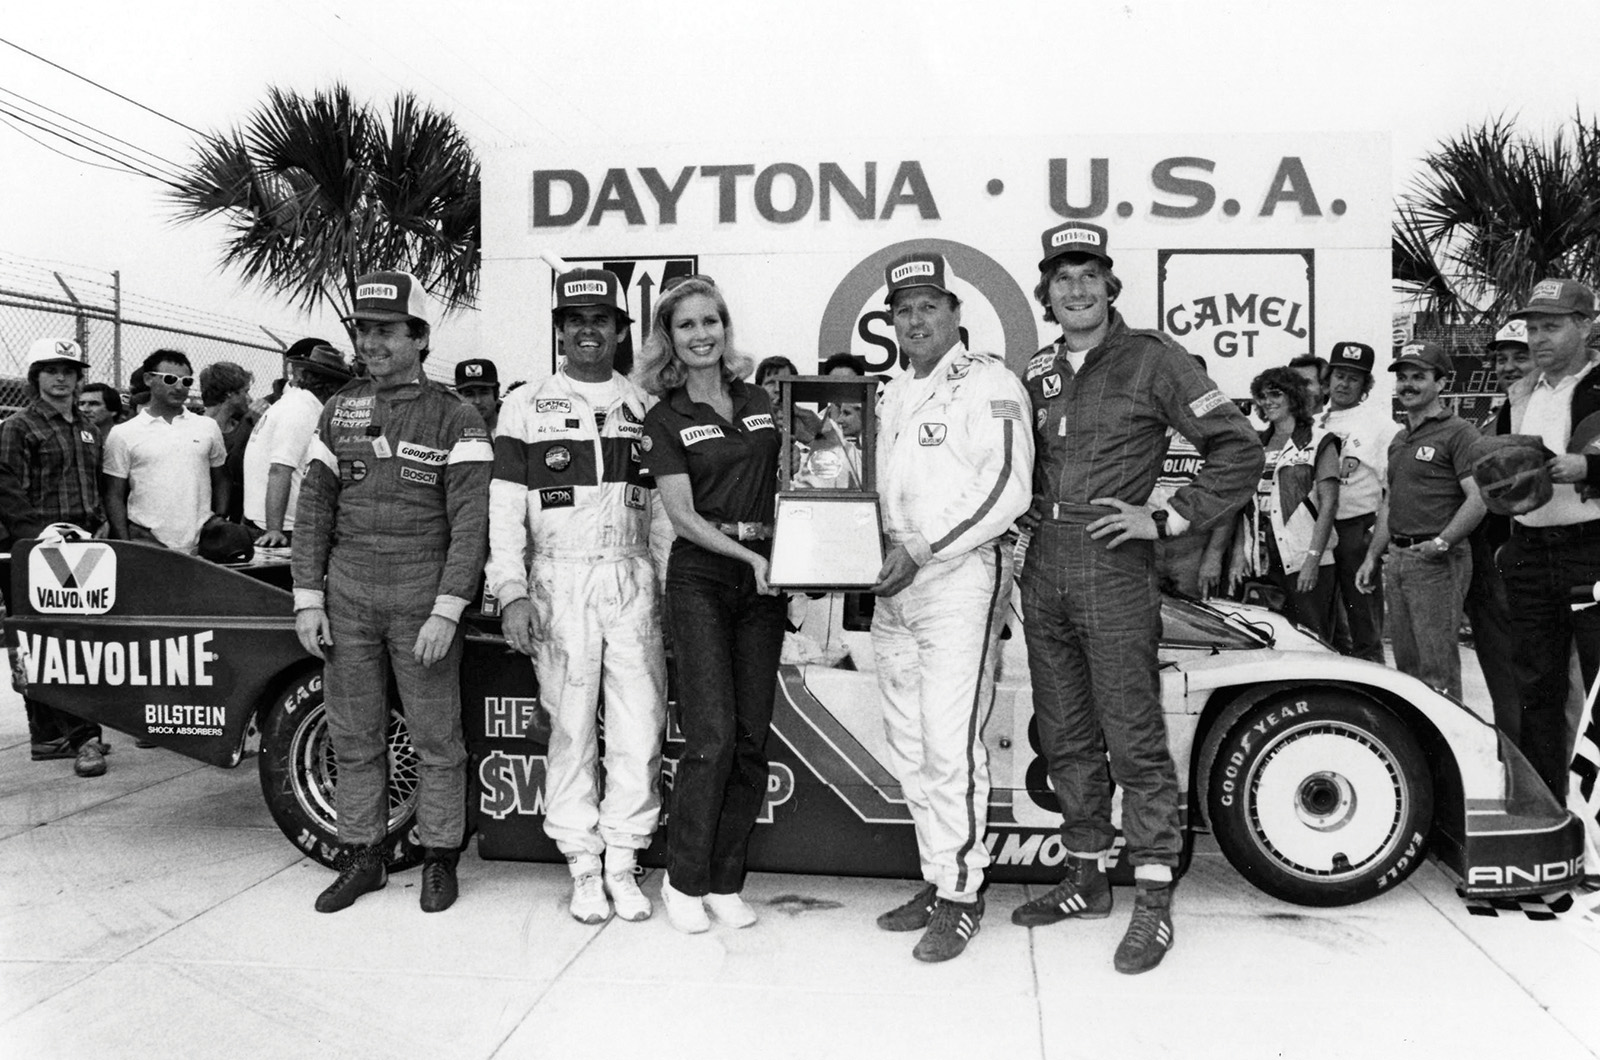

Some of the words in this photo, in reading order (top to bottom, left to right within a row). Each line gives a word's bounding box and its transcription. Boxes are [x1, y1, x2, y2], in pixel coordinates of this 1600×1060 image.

[532, 160, 942, 228] DAYTONA
[1048, 155, 1348, 220] U.S.A.
[1165, 292, 1308, 340] CAMEL
[1213, 329, 1260, 358] GT
[334, 408, 371, 419] RACING
[402, 468, 436, 483] BOSCH
[1163, 458, 1206, 476] OLINE
[17, 630, 214, 686] VALVOLINE
[145, 704, 226, 726] BILSTEIN
[147, 725, 175, 735] SHOCK
[176, 726, 223, 736] ABSORBERS
[1377, 830, 1424, 889] EAGLE
